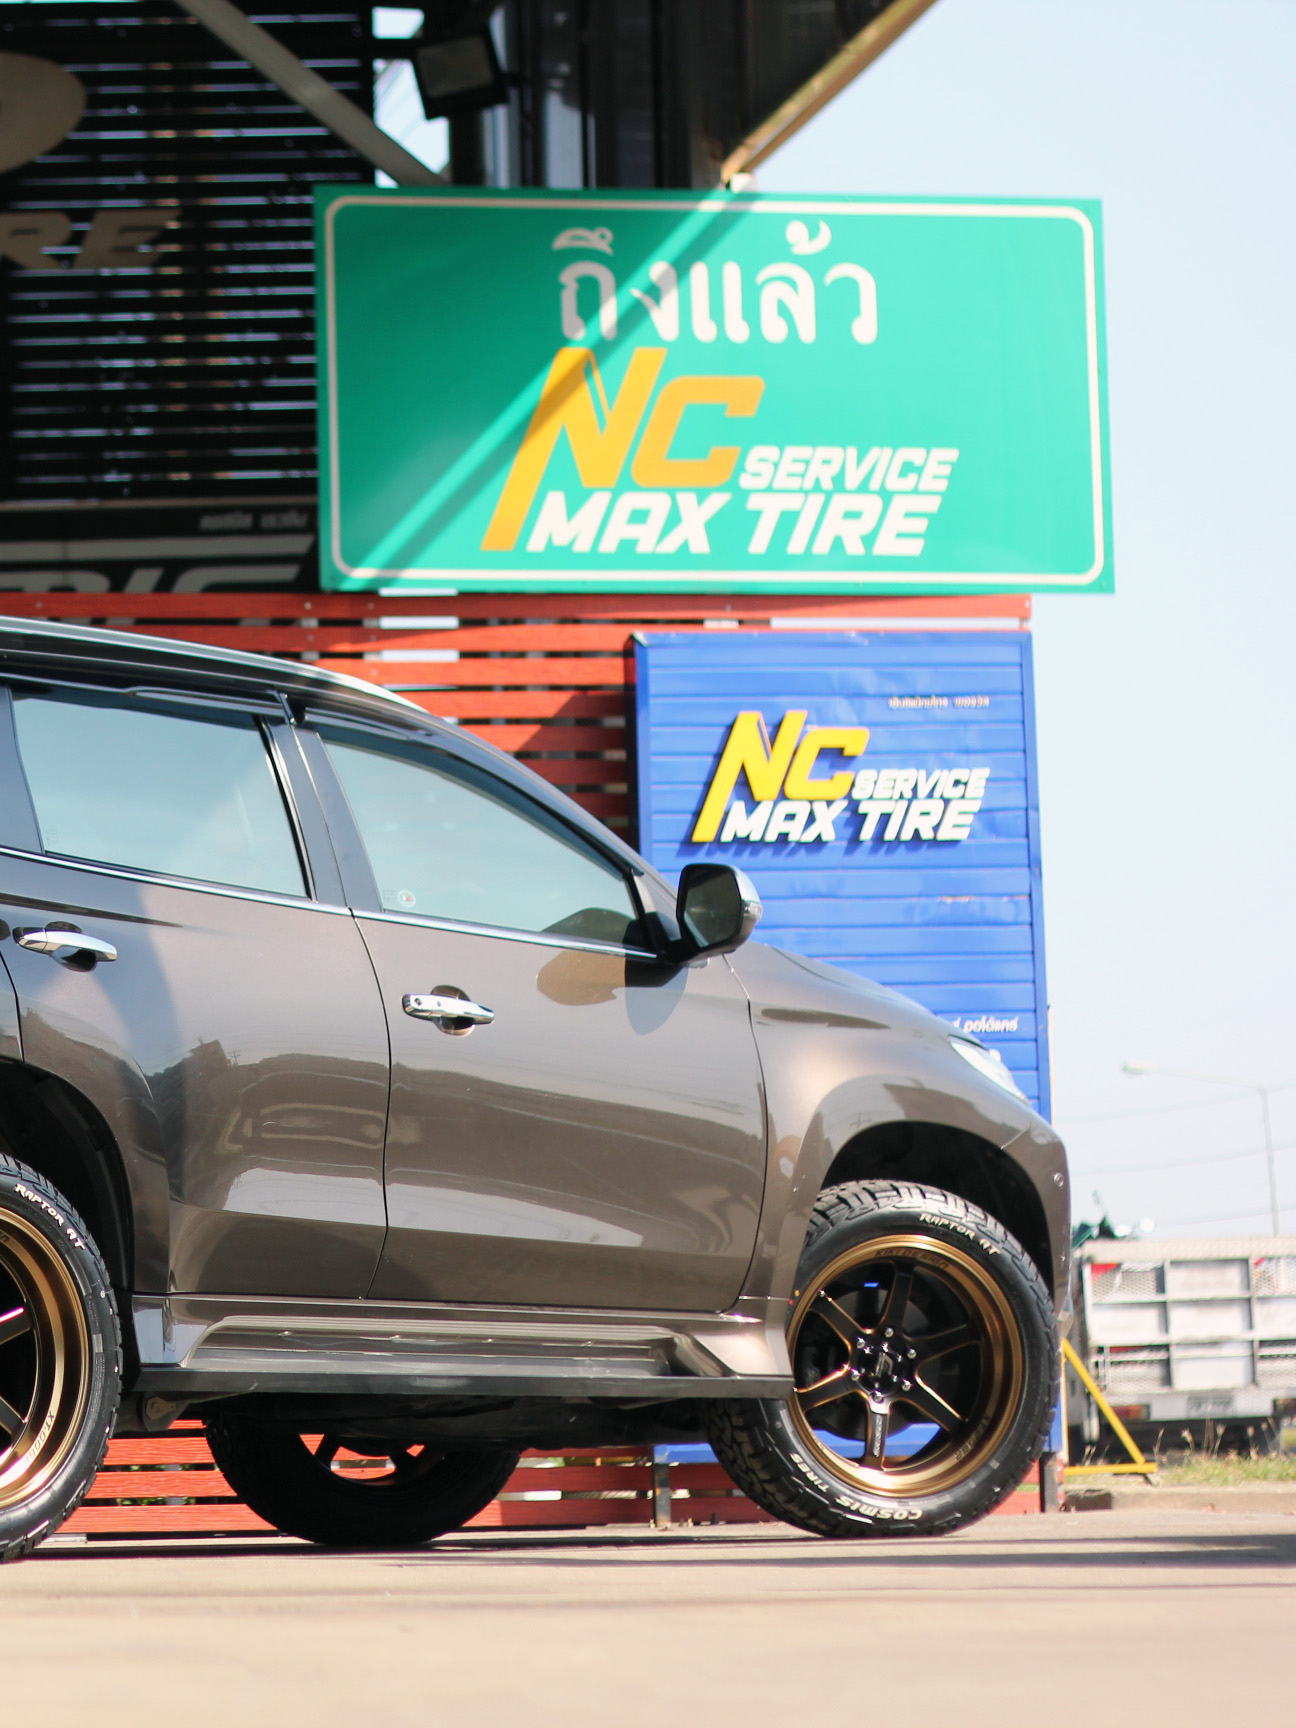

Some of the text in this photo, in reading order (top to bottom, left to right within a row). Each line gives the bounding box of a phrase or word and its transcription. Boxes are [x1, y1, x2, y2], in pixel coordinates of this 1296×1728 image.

[552, 219, 878, 344] ถึงแล้ว
[480, 347, 959, 551] NC SERVICE
[526, 491, 942, 555] MAX TIRE
[691, 710, 990, 842] NC SERVICE
[720, 800, 982, 842] MAX TIRE
[14, 1183, 86, 1250] RAPTOR AT
[919, 1213, 1001, 1255] RAPTOR AT
[789, 1452, 923, 1520] COSMIS TIRES
